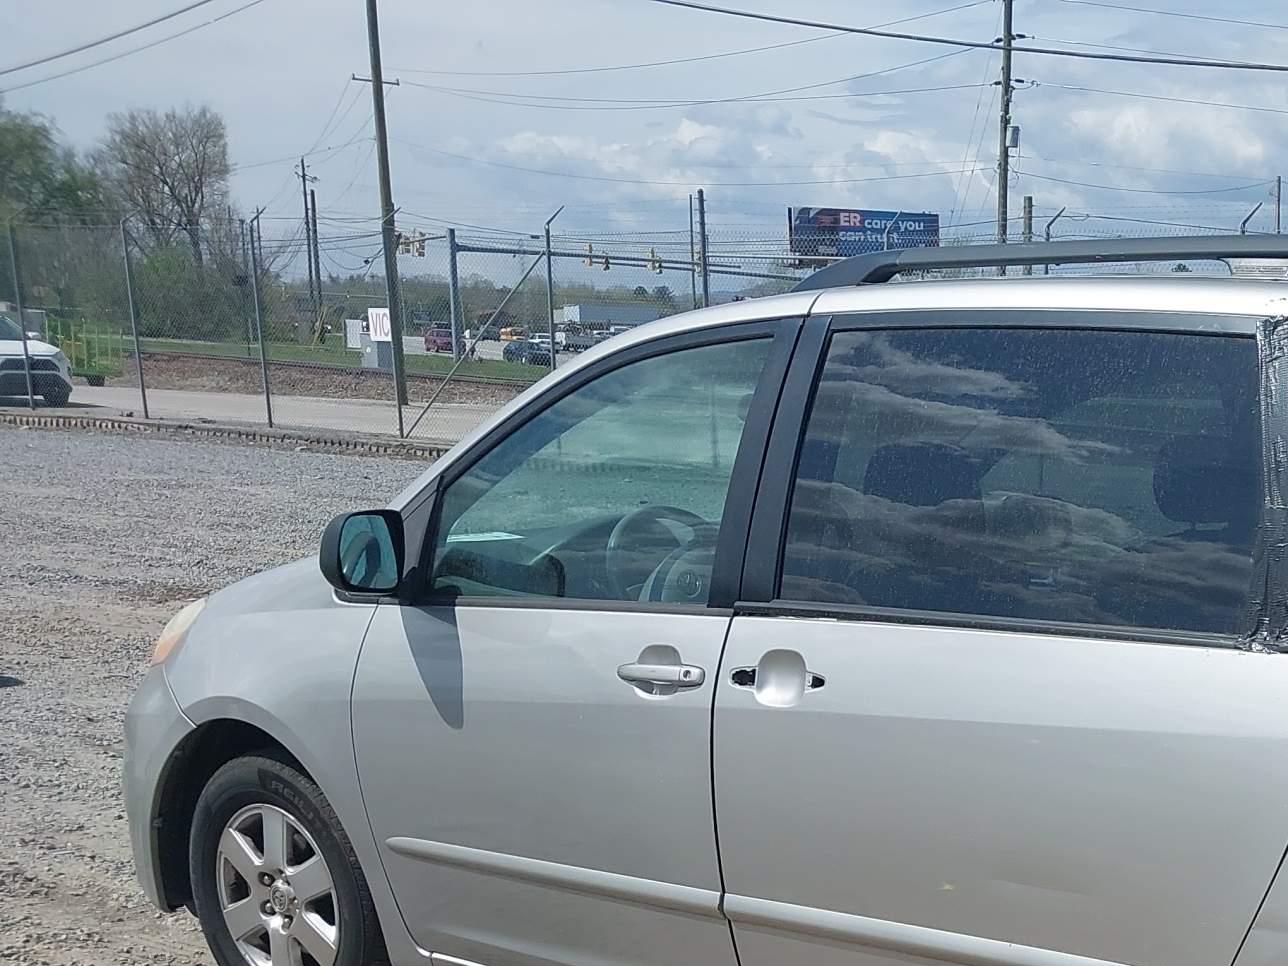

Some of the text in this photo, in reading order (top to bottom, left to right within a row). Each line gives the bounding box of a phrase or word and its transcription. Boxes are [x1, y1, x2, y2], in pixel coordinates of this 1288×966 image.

[839, 212, 924, 232] ER care you
[839, 231, 864, 241] can
